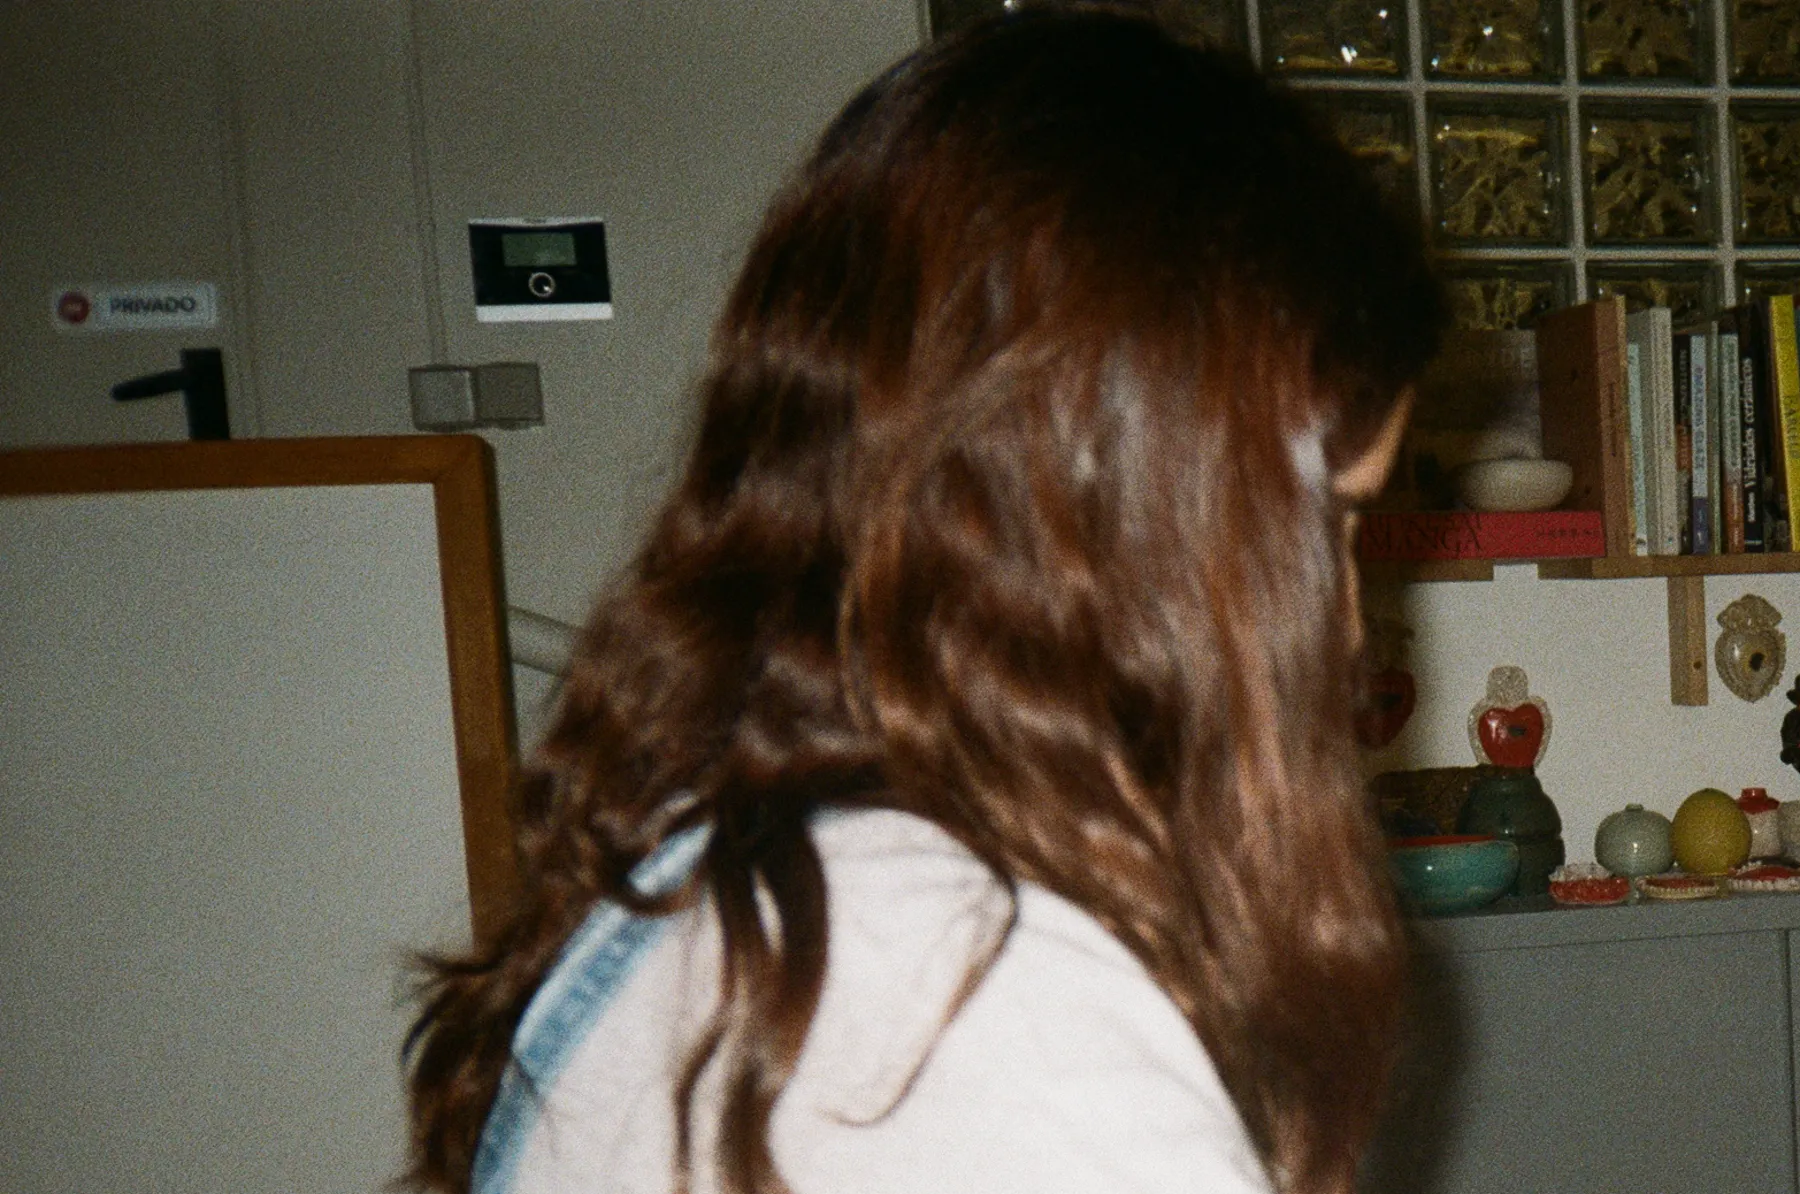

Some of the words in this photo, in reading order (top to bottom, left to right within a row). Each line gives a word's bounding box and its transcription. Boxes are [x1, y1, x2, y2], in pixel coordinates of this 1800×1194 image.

[110, 296, 197, 314] PRIVADO
[1741, 357, 1755, 424] cerámicos
[1742, 426, 1757, 489] Vidriados
